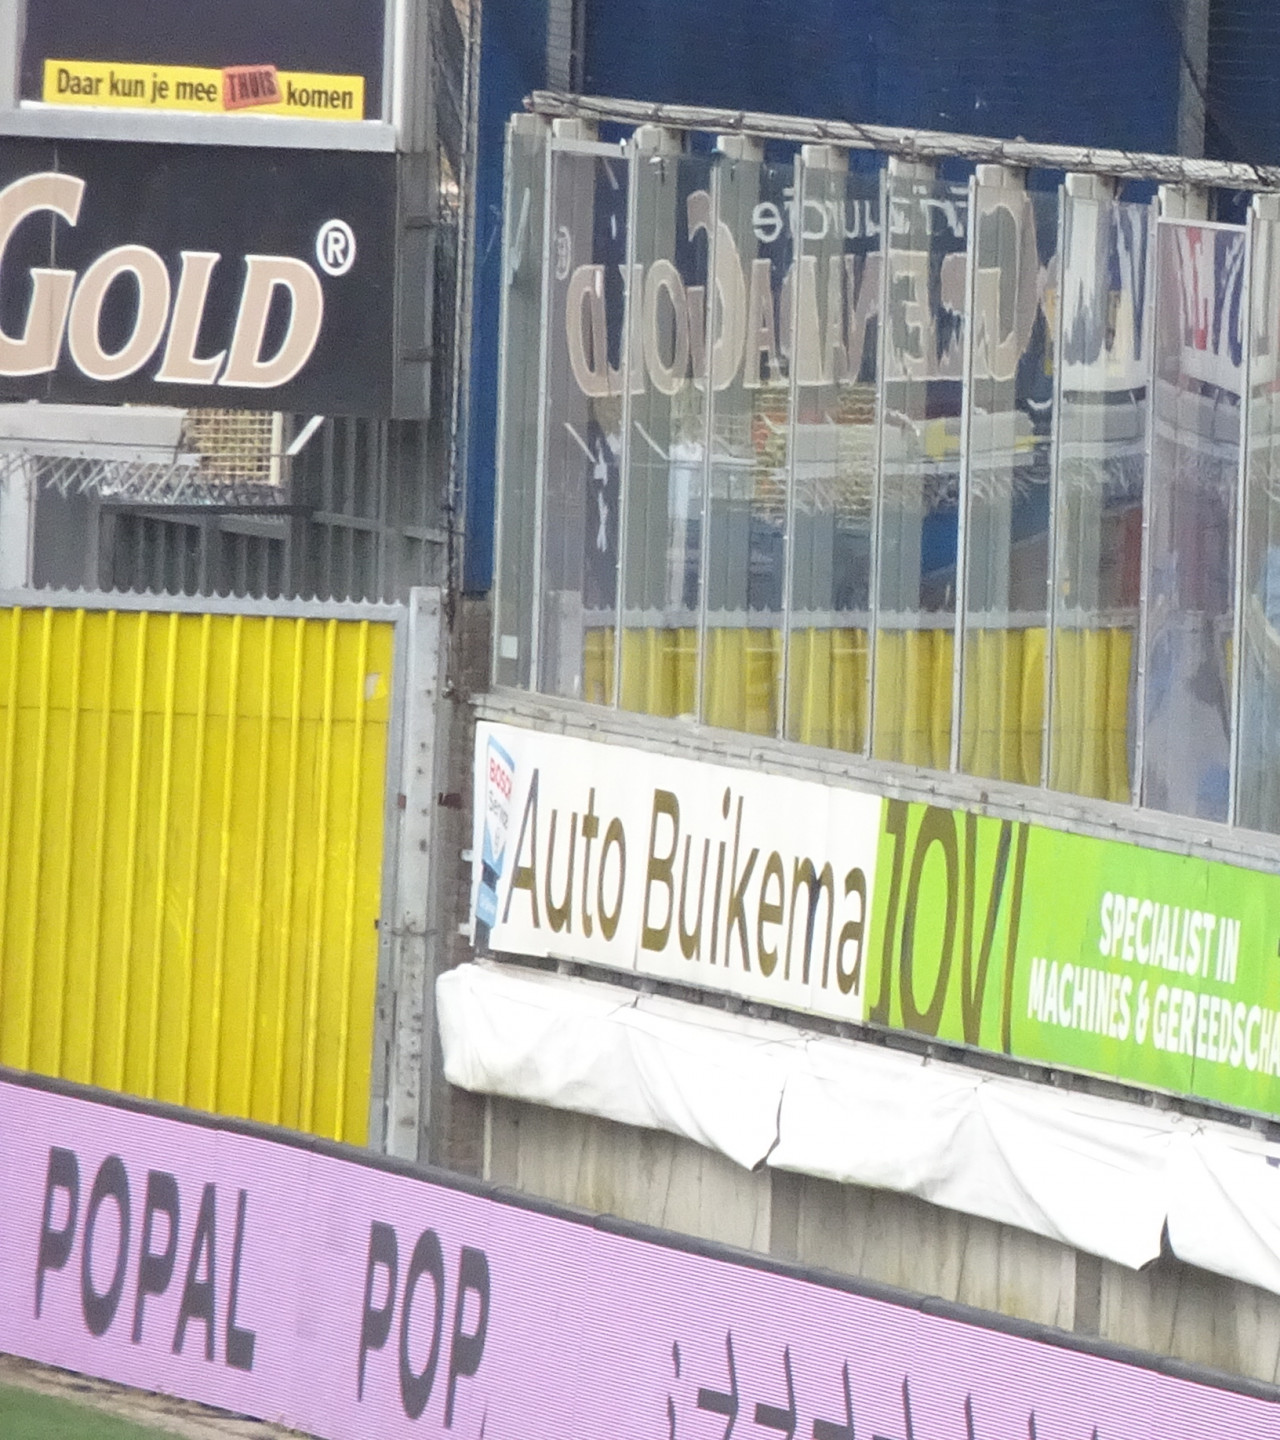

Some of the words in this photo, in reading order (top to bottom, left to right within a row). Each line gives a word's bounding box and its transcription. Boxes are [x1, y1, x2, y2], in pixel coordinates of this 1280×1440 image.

[56, 68, 103, 96] Daar
[108, 71, 145, 100] kun
[150, 73, 171, 104] je
[175, 81, 218, 103] mee
[286, 81, 354, 111] komen
[501, 767, 627, 943] Auto
[640, 785, 868, 997] Buikema
[1098, 890, 1217, 979] SPECIALIST
[1215, 917, 1241, 985] IN
[1027, 957, 1132, 1042] MACHINES
[1135, 979, 1151, 1045] &
[34, 1144, 257, 1373] POPAL
[356, 1219, 492, 1430] POP
